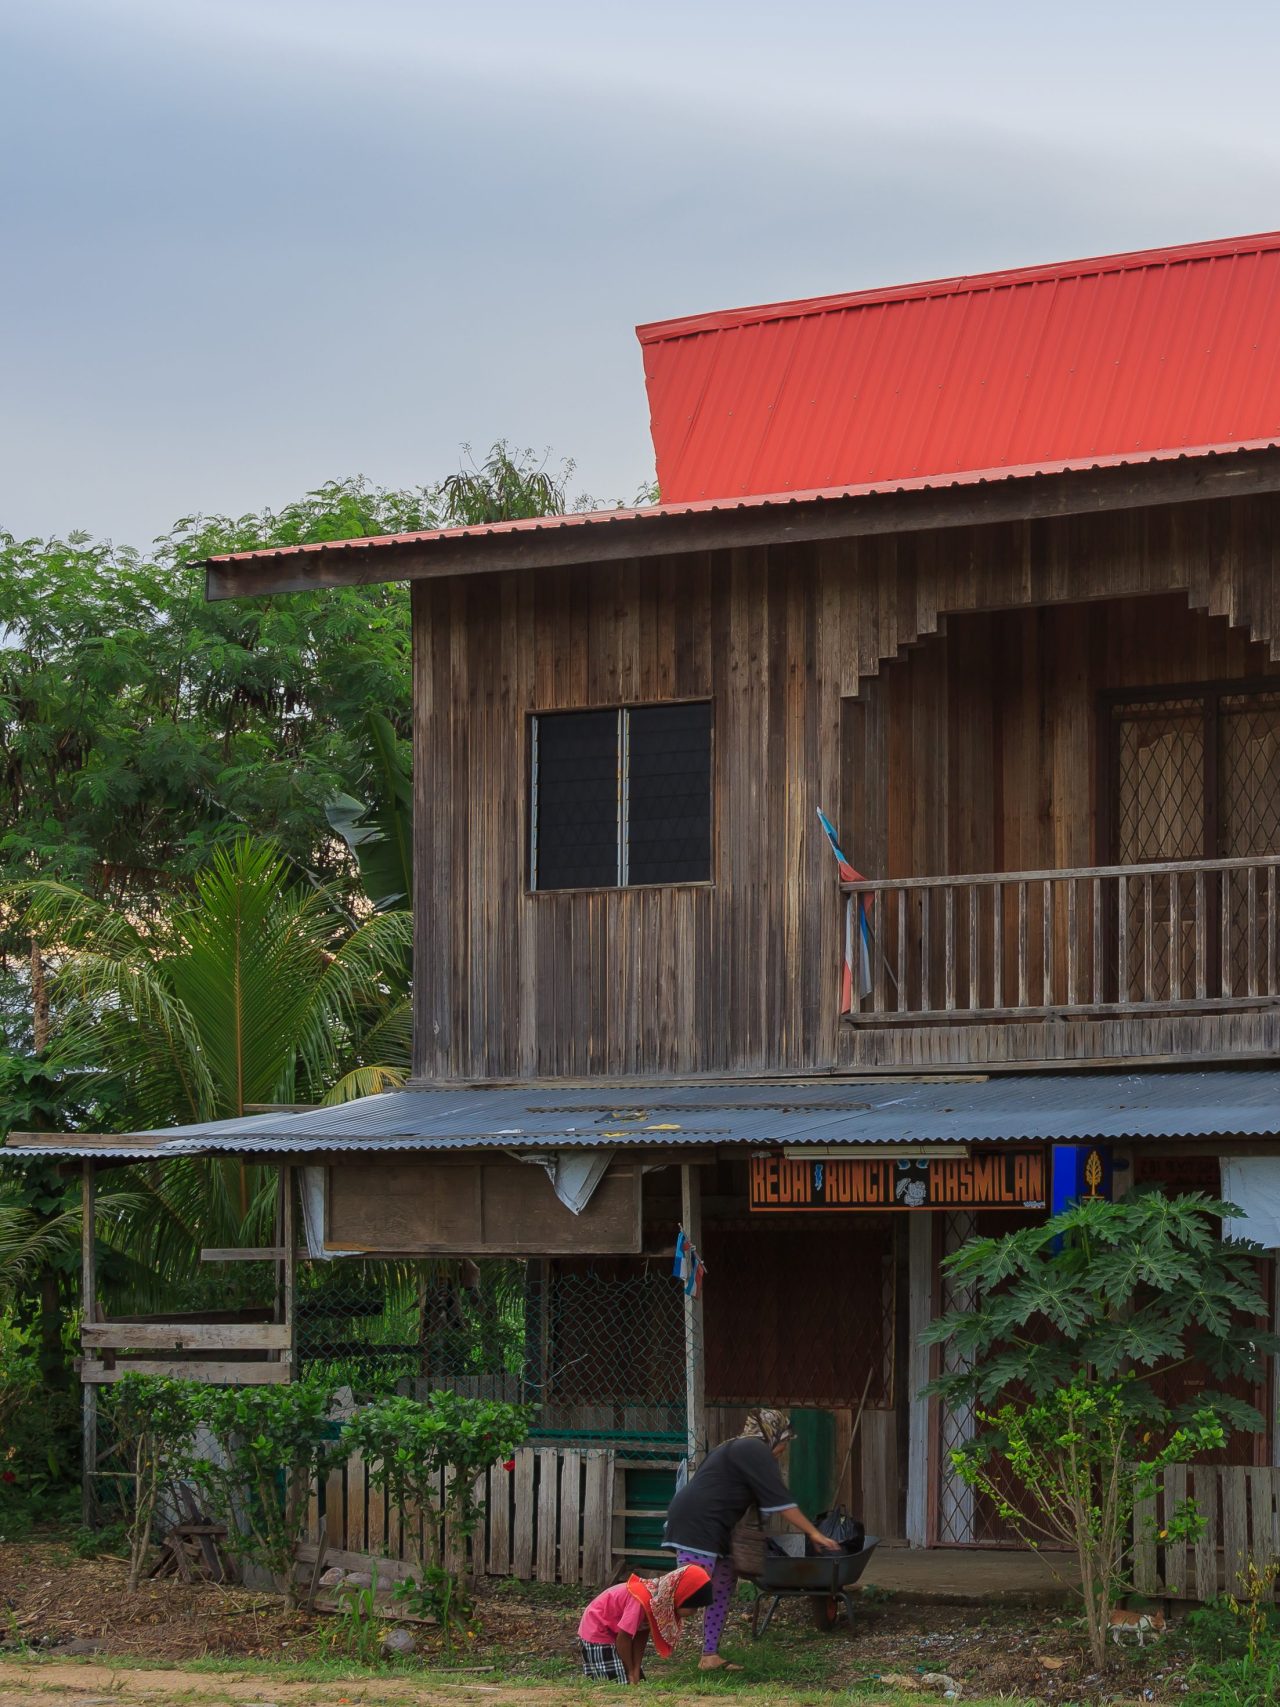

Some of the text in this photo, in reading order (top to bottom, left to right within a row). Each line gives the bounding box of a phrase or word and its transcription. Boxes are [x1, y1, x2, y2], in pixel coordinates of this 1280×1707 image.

[752, 1154, 1043, 1202] KEDAI RUNCIT HASMILAN
